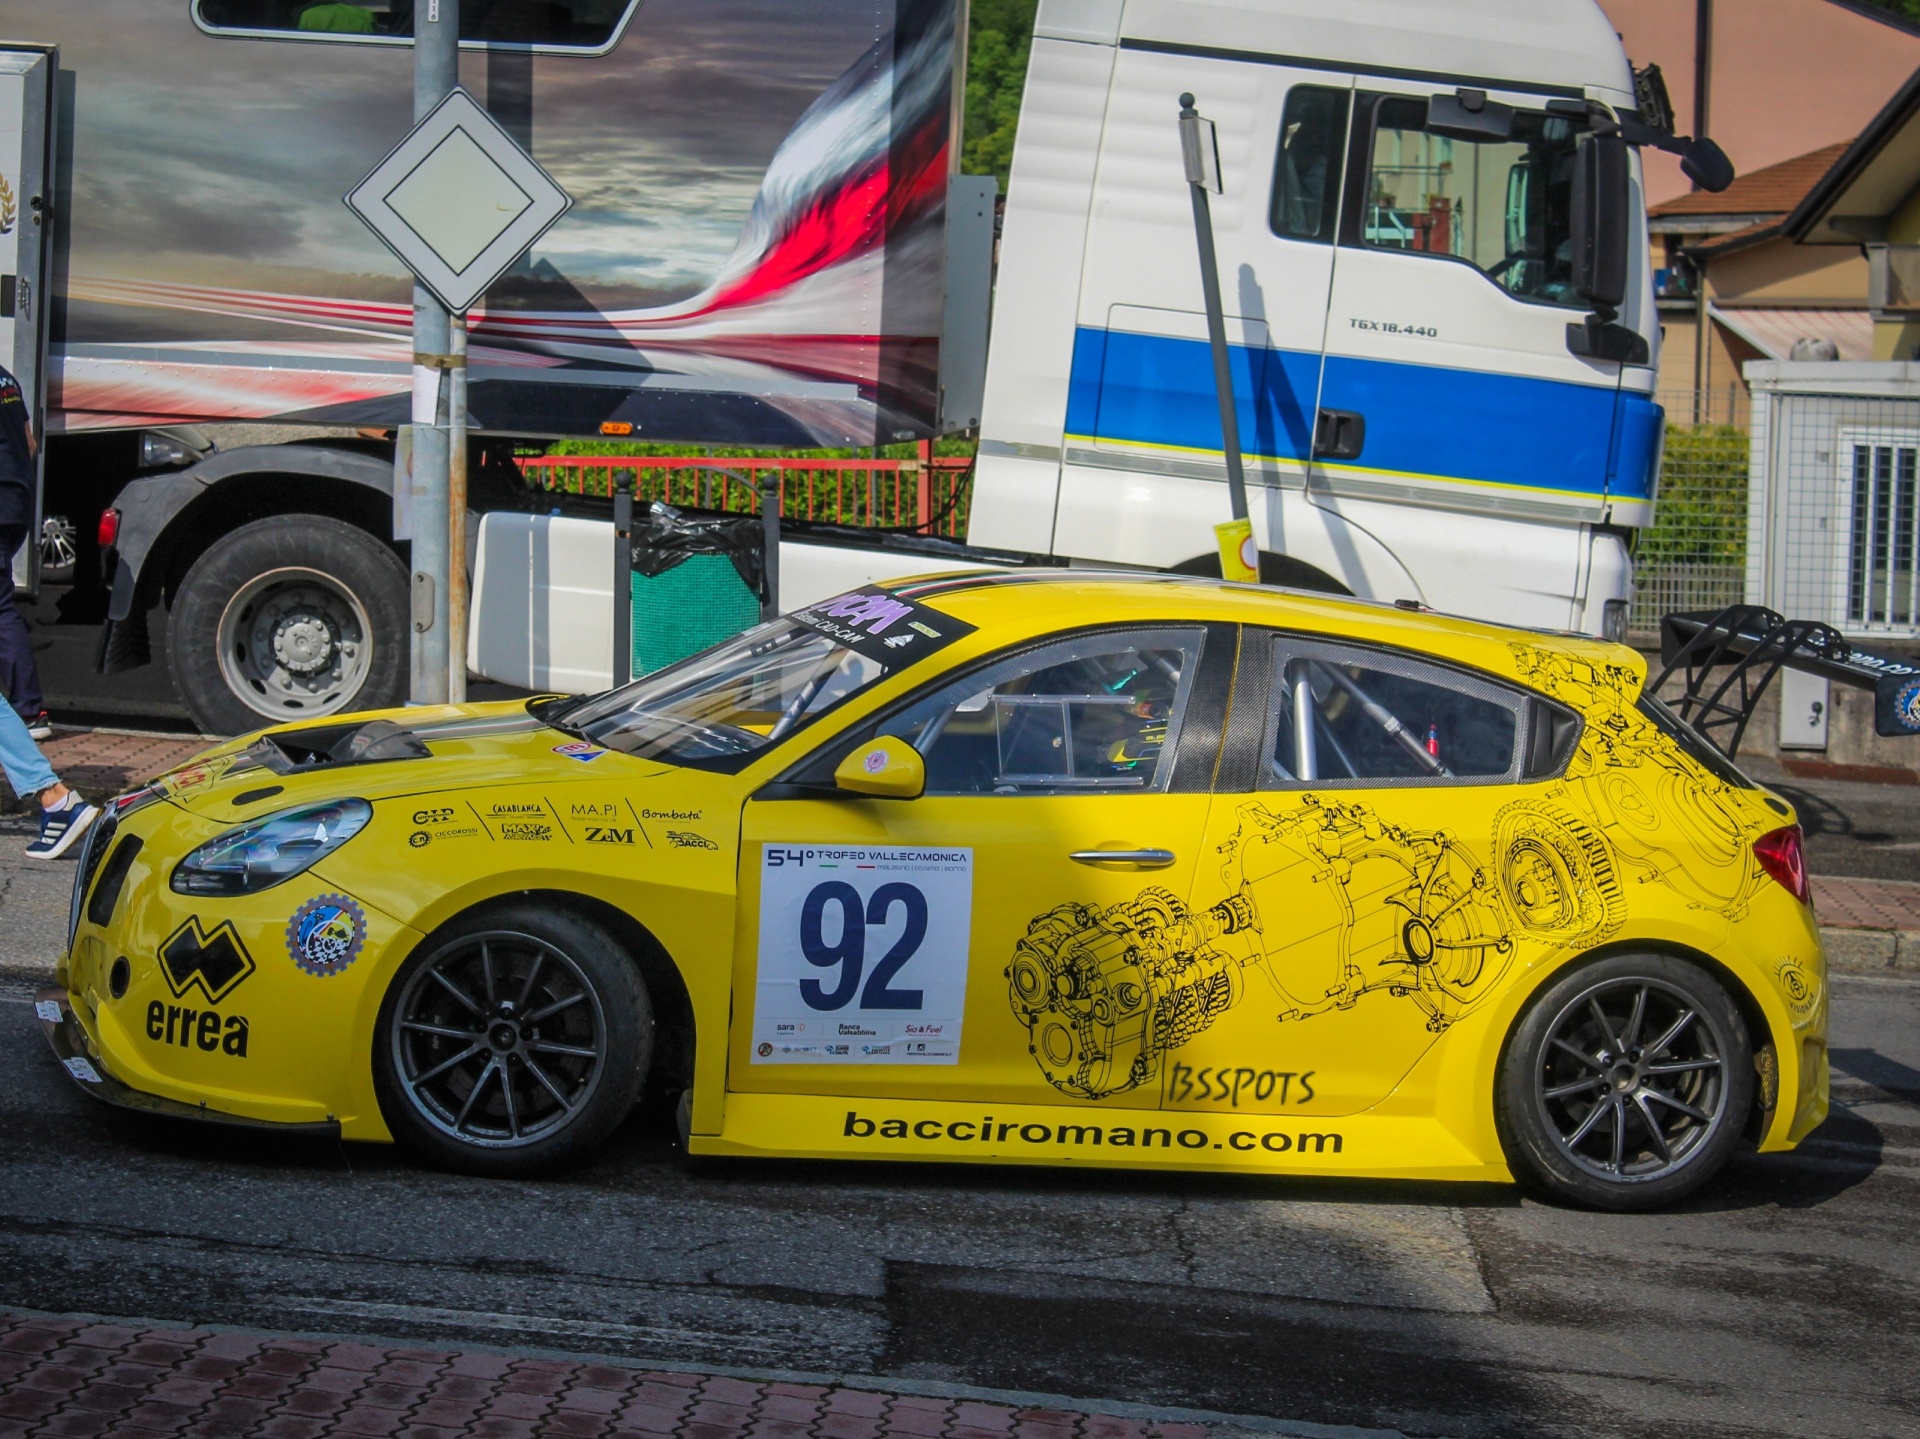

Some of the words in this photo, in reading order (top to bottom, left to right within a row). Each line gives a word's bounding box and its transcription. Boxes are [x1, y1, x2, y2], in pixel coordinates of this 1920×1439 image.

[1349, 318, 1379, 331] TGX
[1382, 323, 1438, 337] 18.440
[815, 620, 865, 643] CAD-CAM
[493, 804, 541, 814] CASABLANCA
[434, 828, 478, 838] CICCOROSSI
[676, 836, 707, 848] BACCI
[817, 851, 865, 860] TROFEO
[869, 852, 967, 862] VALLECAMONICA
[800, 880, 928, 1011] 92
[1789, 992, 1815, 1013] VISIONAIR
[926, 1025, 943, 1033] Fuel
[843, 1111, 1344, 1154] bacciromano.com
